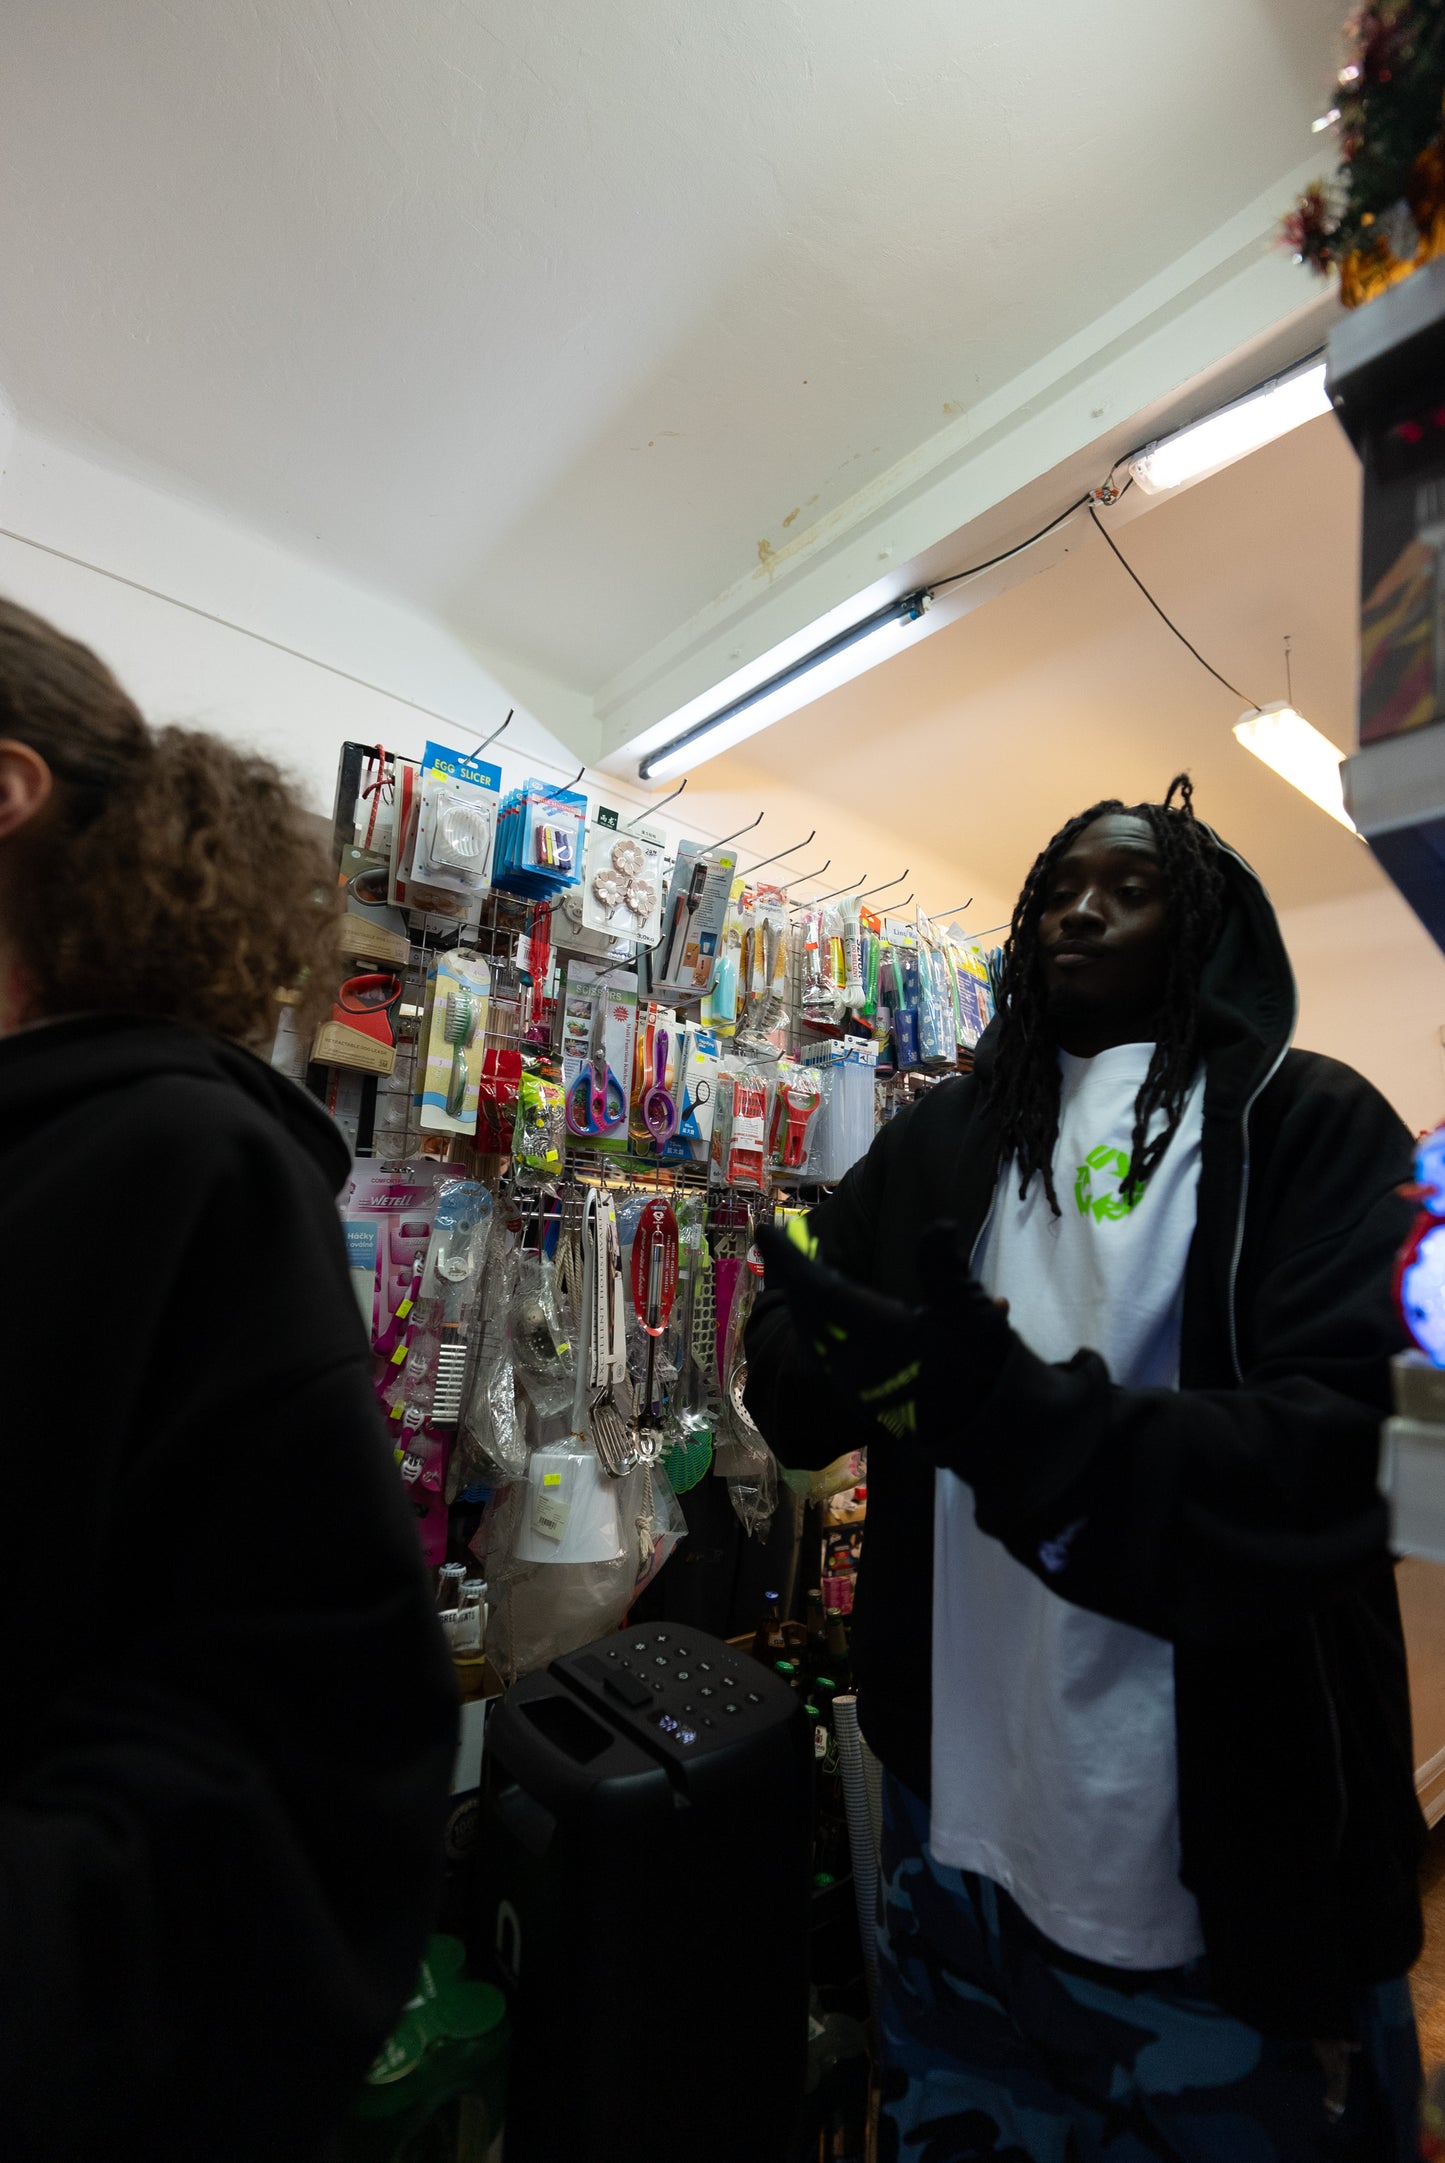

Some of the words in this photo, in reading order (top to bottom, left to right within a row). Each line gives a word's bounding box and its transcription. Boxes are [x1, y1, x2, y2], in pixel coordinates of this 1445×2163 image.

[434, 758, 456, 774] EGG
[460, 767, 492, 786] SLICER
[347, 1231, 375, 1242] Háčky
